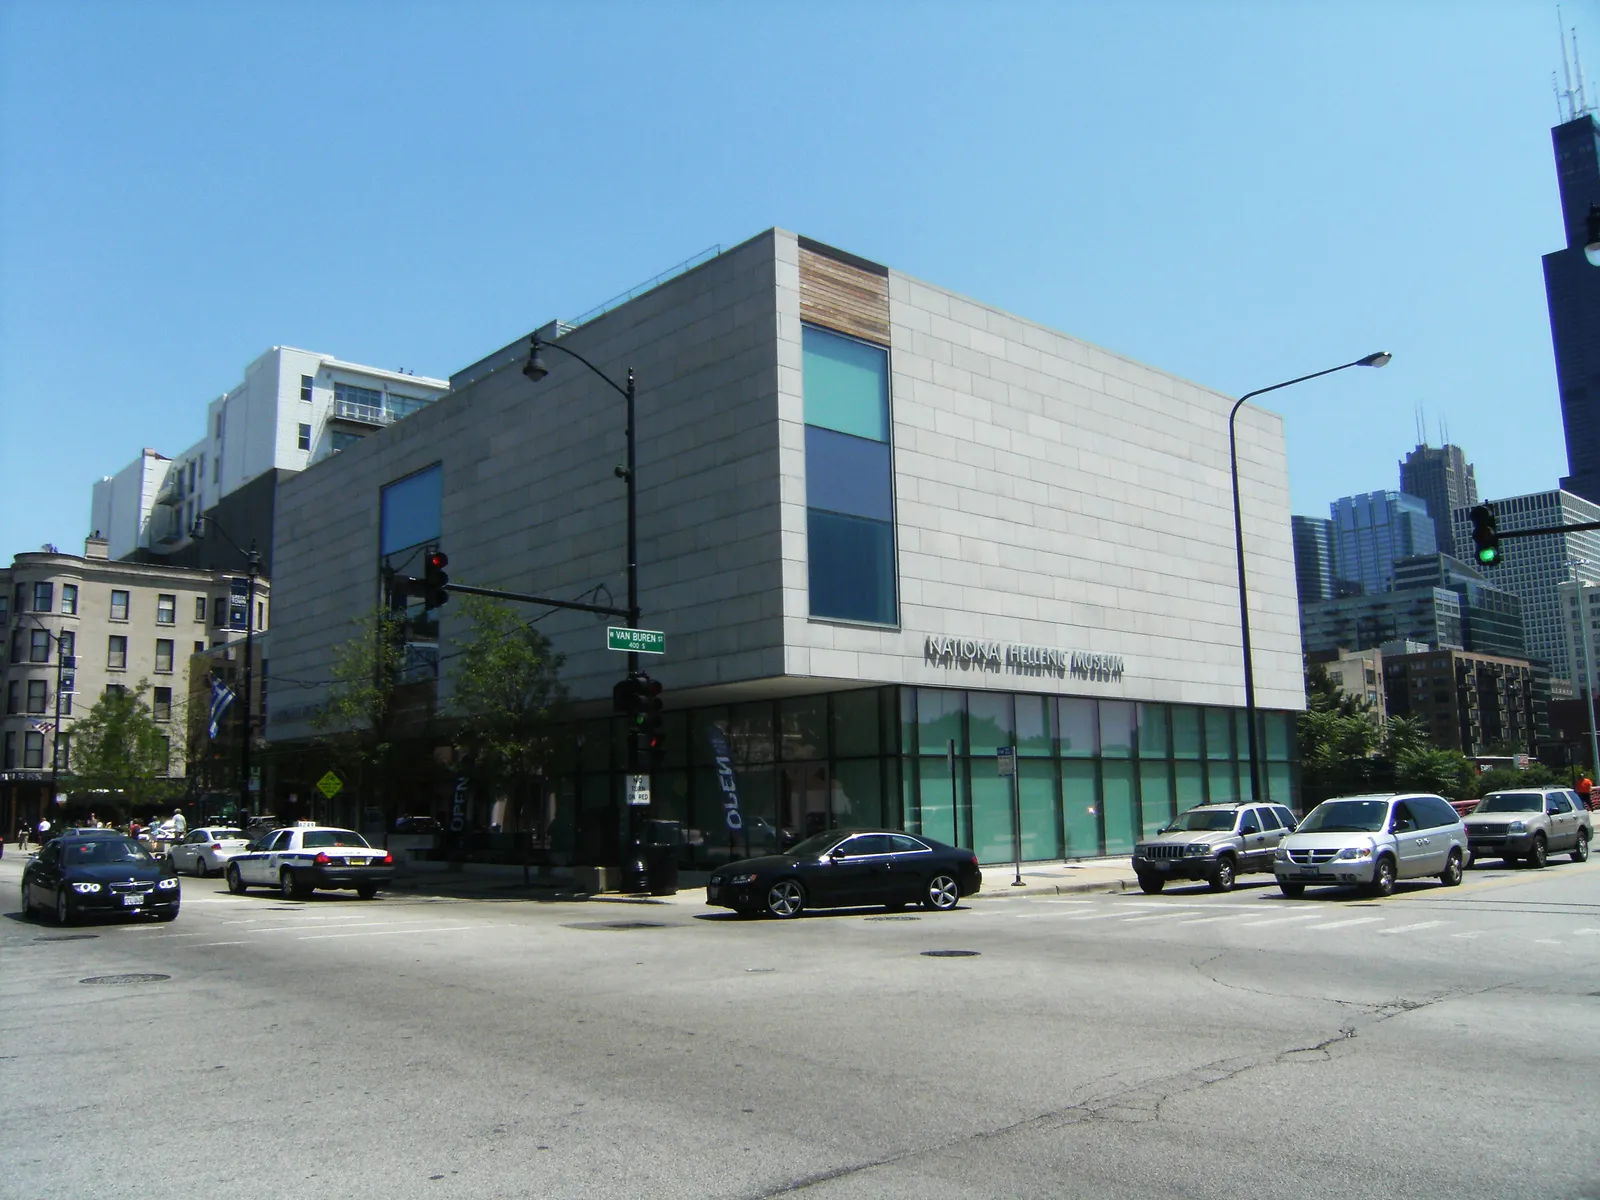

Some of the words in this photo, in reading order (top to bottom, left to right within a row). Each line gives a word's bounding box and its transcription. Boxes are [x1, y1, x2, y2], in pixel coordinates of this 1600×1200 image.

[615, 631, 631, 641] VAN
[632, 632, 656, 643] BUREN
[1005, 644, 1069, 672] HELLENIC
[1069, 651, 1125, 676] MUSEUM
[449, 776, 470, 832] OPEN
[638, 793, 649, 801] RED
